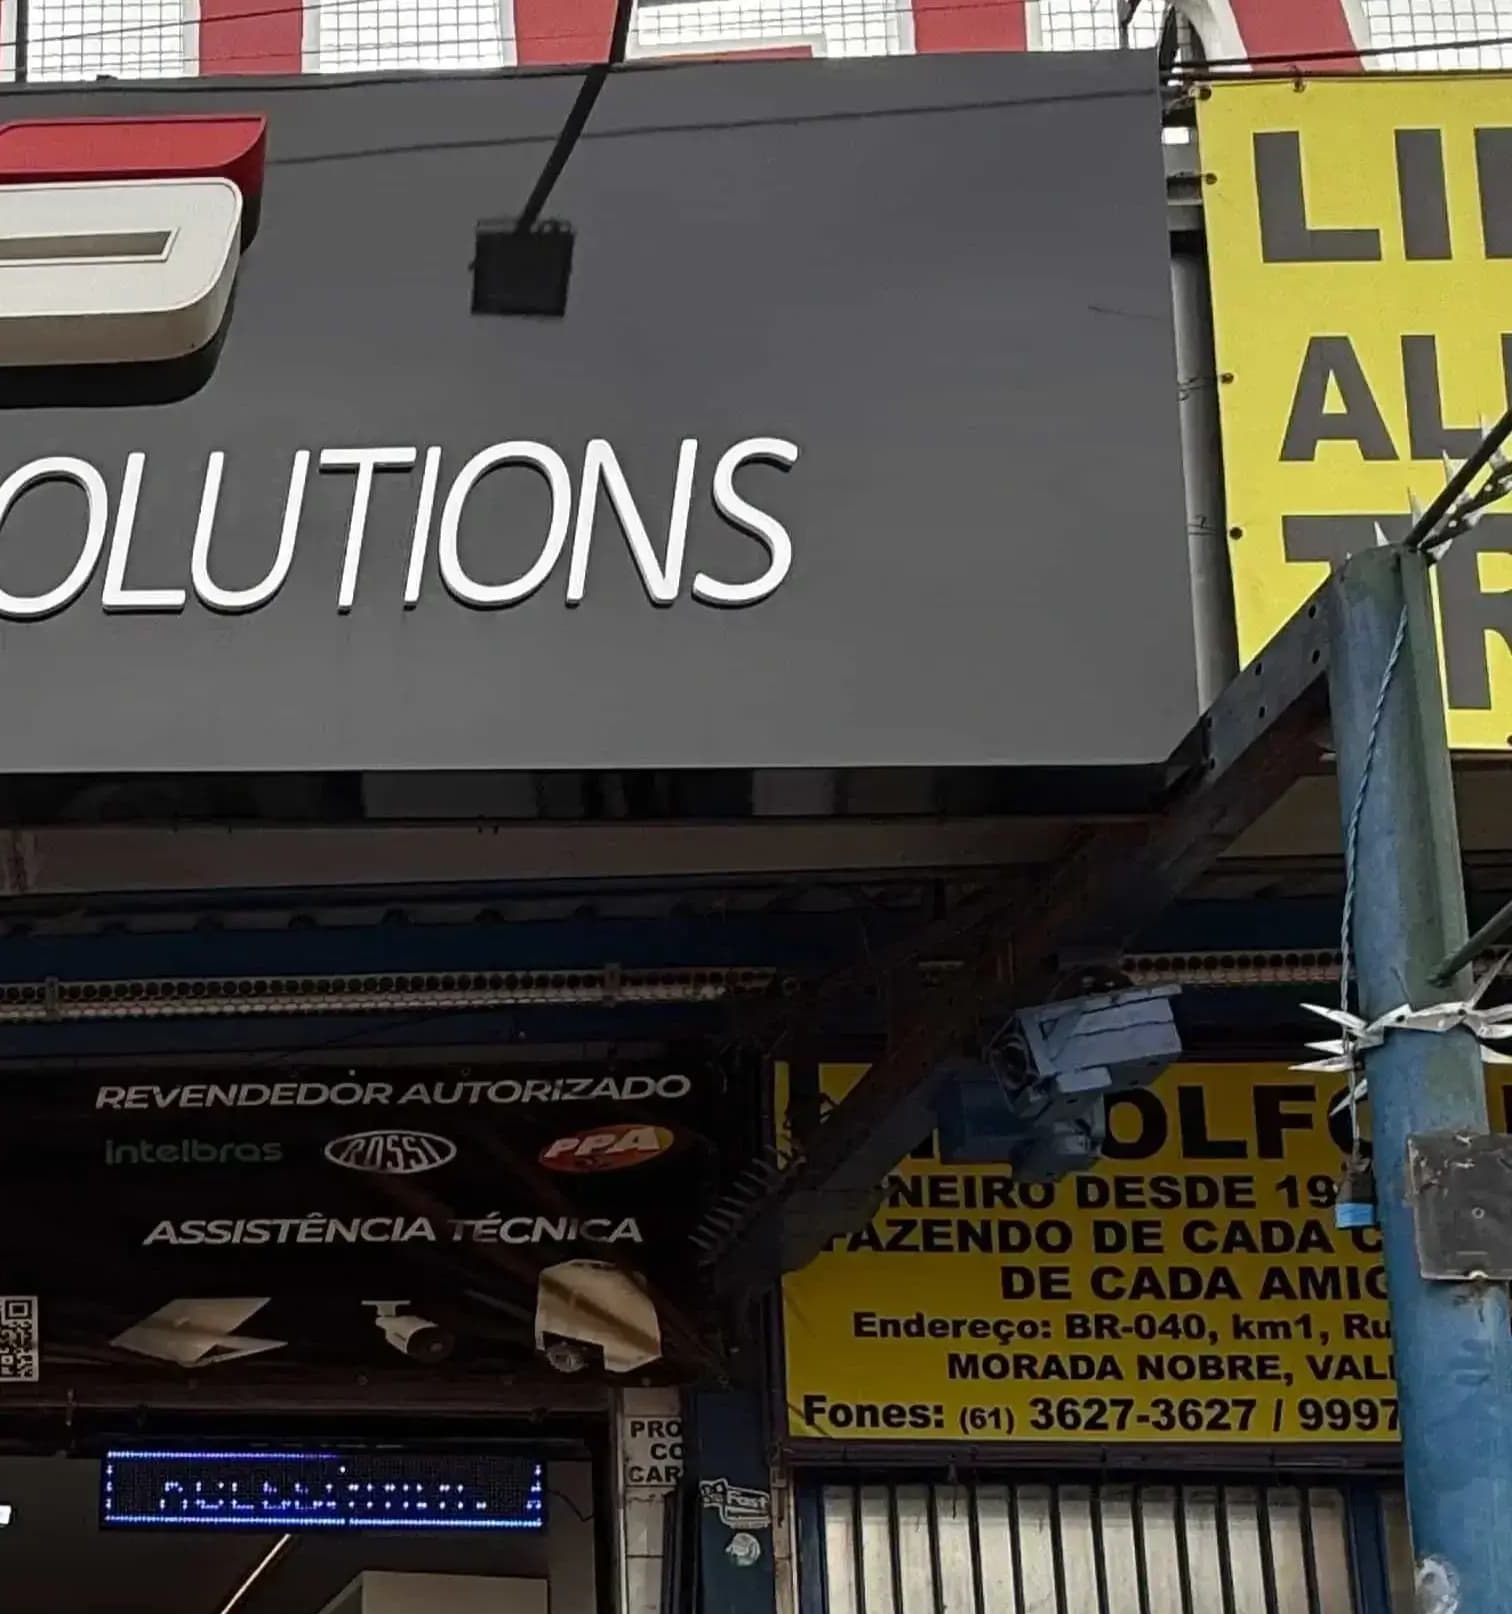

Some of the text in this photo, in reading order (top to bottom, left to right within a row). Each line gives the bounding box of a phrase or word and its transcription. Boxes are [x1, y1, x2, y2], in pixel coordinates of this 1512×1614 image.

[1279, 333, 1512, 462] AL
[95, 1074, 691, 1110] REVENDEDOR AUTORIZADO
[104, 1138, 284, 1167] intelbras
[339, 1135, 443, 1171] ROSSI
[543, 1126, 663, 1160] PPA
[1075, 1175, 1257, 1209] DESDE
[142, 1211, 644, 1246] ASSISTÊNCIA TÉCNICA
[1092, 1219, 1165, 1254] DE
[1183, 1218, 1335, 1254] CADA
[1000, 1266, 1072, 1300] DE
[1091, 1265, 1242, 1300] CADA
[853, 1312, 1052, 1345] Endereço:
[1065, 1313, 1218, 1345] BR-040,
[948, 1353, 1123, 1380] MORADA
[1138, 1355, 1293, 1386] NOBRE,
[803, 1395, 944, 1428] Fones:
[960, 1407, 1015, 1434] (61)
[1029, 1397, 1257, 1431] 3627-3627
